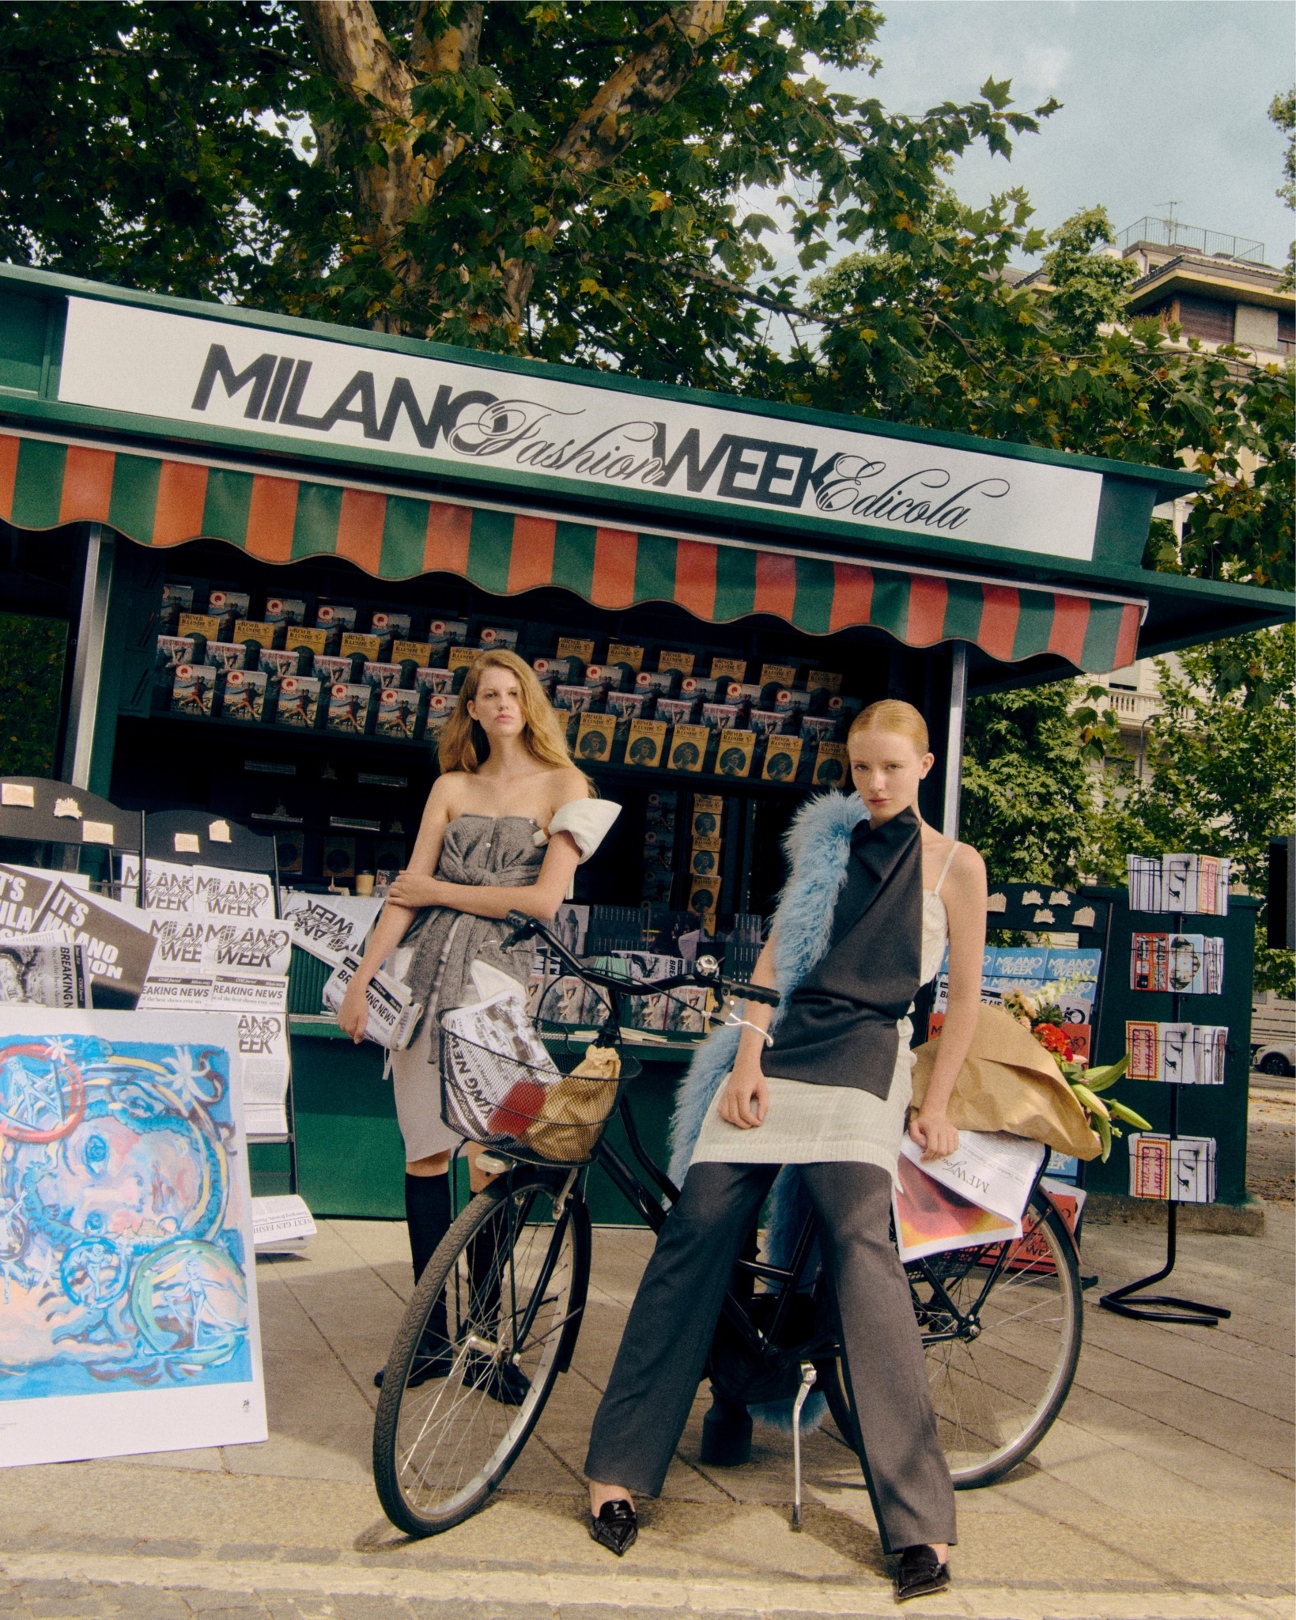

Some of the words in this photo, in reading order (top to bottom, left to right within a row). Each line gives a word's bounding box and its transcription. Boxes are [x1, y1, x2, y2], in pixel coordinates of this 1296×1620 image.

[191, 344, 508, 453] MILANO
[447, 399, 663, 485] Fashion
[655, 421, 842, 508] WEEK
[816, 455, 1009, 531] Edicola
[0, 870, 26, 902] T'S
[124, 866, 193, 893] MLANO
[196, 876, 269, 900] MILANO
[50, 888, 89, 927] IT'S
[207, 898, 258, 918] WEEK
[38, 911, 119, 964] MANO
[204, 924, 290, 949] MILANO
[162, 942, 201, 962] WEE
[217, 946, 271, 968] WEEK
[995, 956, 1043, 968] MILANO
[60, 946, 73, 1000] BREAKING
[1001, 965, 1034, 975] WEEK
[1047, 957, 1096, 969] MILANO
[141, 985, 178, 996] EAKING
[179, 987, 209, 998] NEWS
[213, 985, 254, 997] REAKING
[255, 988, 284, 999] NEWS
[238, 1015, 281, 1034] ANO
[376, 1003, 397, 1026] NEWS
[239, 1039, 273, 1054] EEK
[953, 1167, 990, 1193] MFW
[1153, 1148, 1164, 1192] MILANO
[253, 1224, 274, 1234] FASHI
[276, 1222, 292, 1230] GEN
[294, 1218, 312, 1227] NEXT
